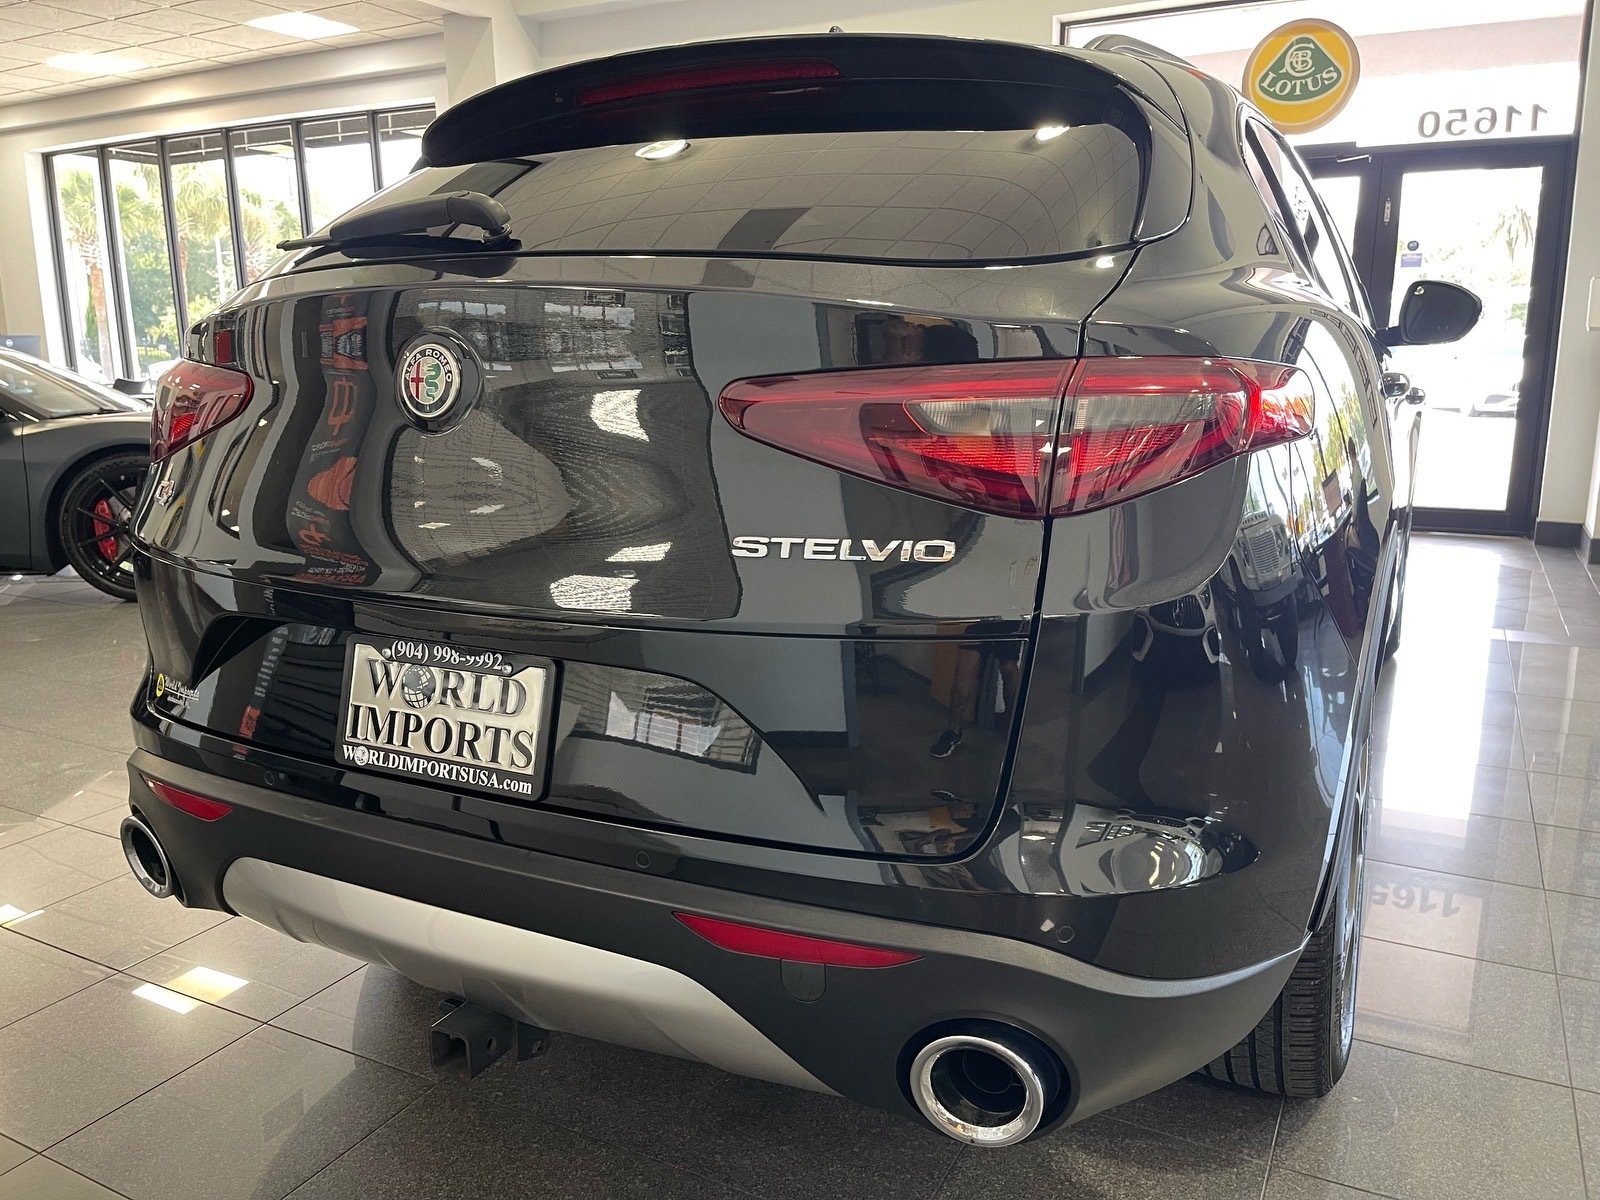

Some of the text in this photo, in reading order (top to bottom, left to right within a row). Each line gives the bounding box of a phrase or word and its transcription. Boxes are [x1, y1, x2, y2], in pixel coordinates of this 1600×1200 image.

[1260, 66, 1338, 96] LOTUS
[405, 348, 453, 382] ALFA ROMEO
[731, 535, 956, 563] STELVIO
[391, 640, 429, 664] (904)
[367, 657, 528, 717] WORLD
[348, 703, 535, 770] IMPORTS
[341, 744, 533, 795] WORLDIMPORTSUSA.com
